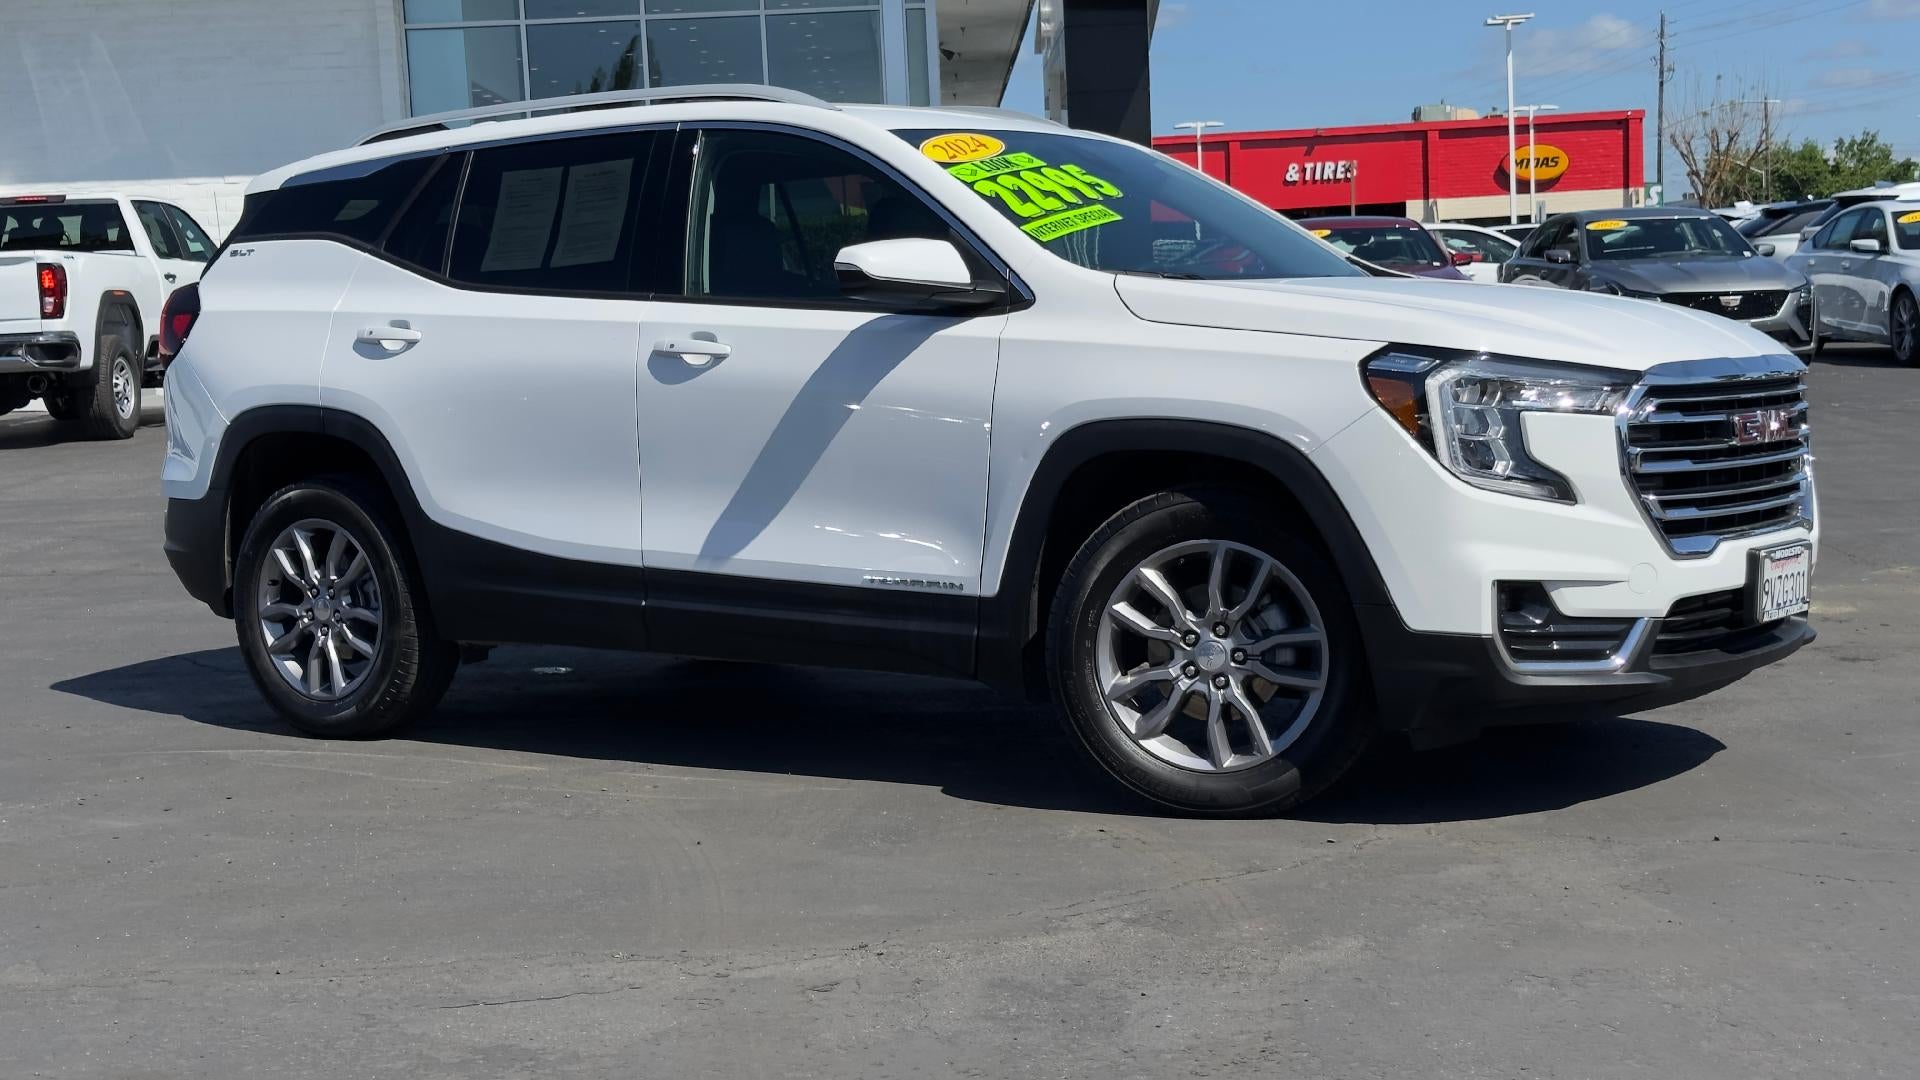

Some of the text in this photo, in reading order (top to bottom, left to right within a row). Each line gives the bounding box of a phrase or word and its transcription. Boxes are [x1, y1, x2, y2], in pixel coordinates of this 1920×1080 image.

[933, 136, 989, 160] 2024
[1285, 163, 1299, 182] &
[973, 164, 1123, 217] 22995
[1029, 216, 1077, 239] INTERNET
[1734, 409, 1798, 445] GMC
[1763, 570, 1805, 610] 9VZG301
